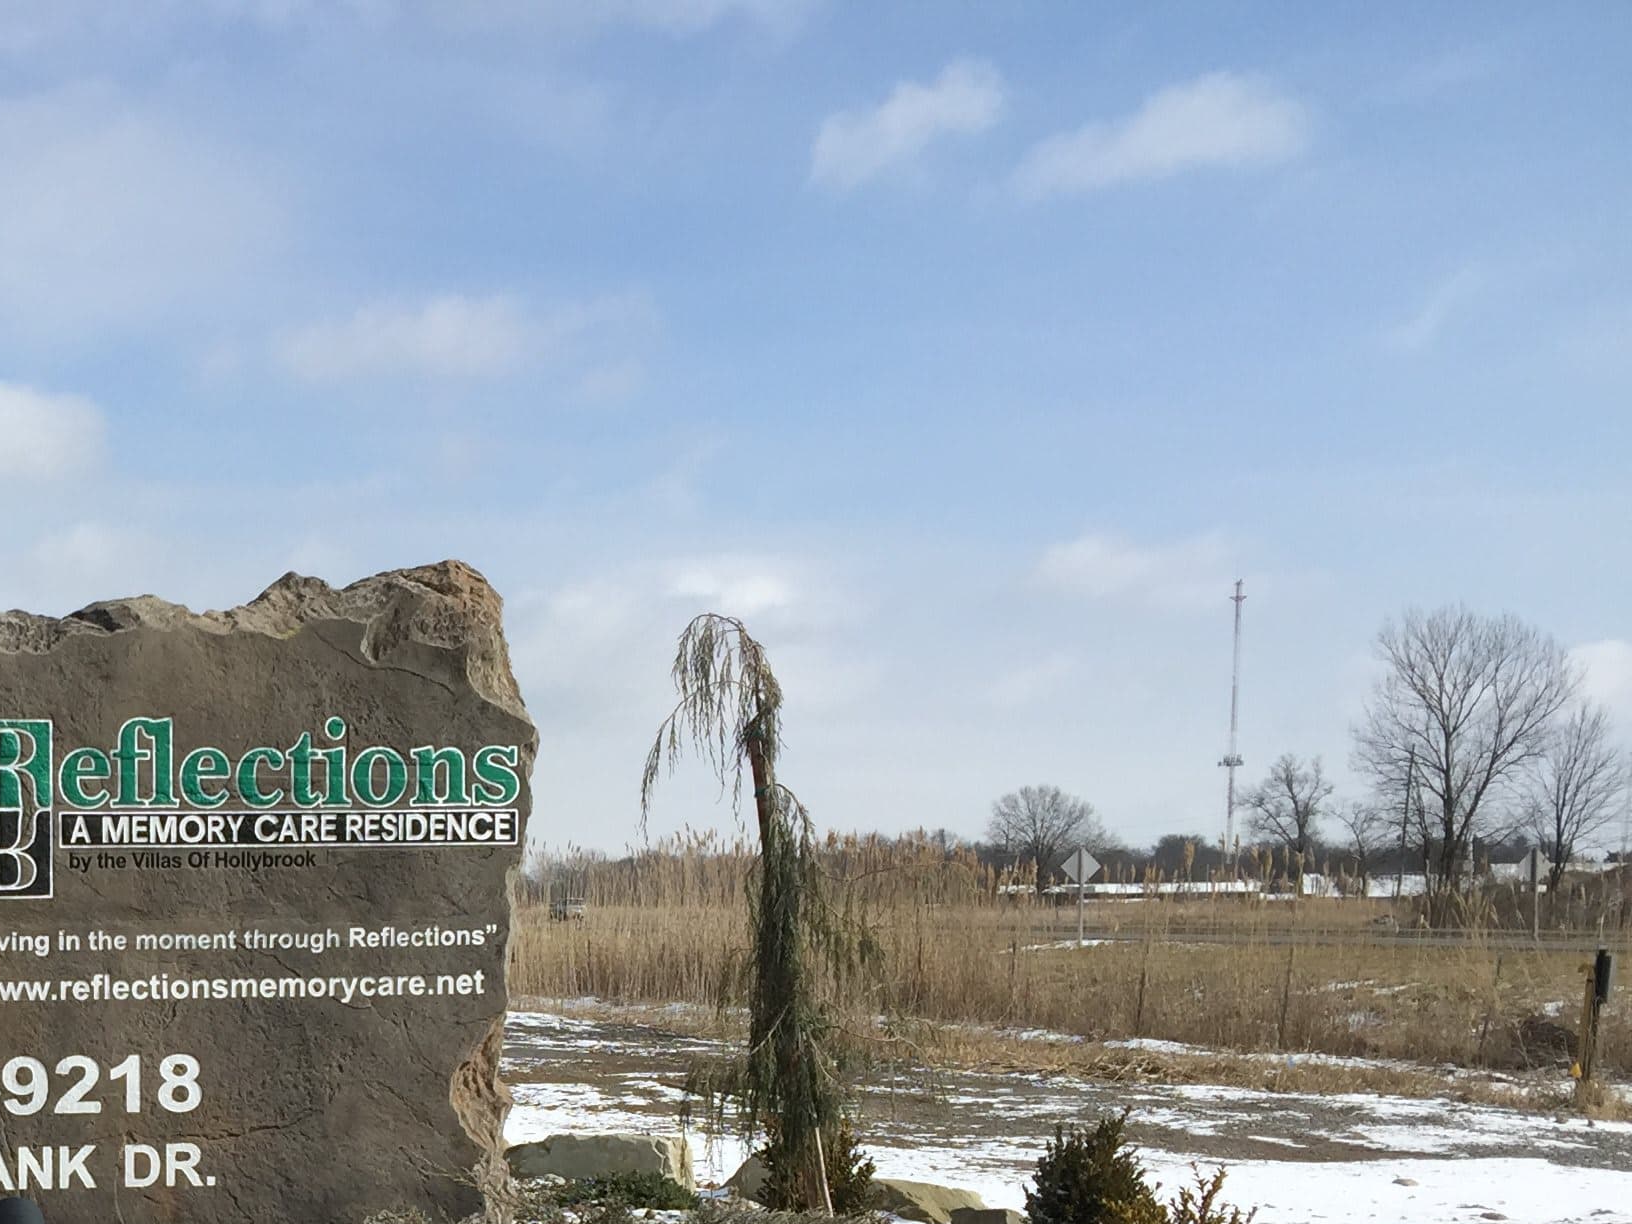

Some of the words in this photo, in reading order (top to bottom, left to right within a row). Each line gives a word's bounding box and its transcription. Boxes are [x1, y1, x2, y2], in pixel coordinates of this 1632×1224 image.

[70, 815, 91, 844] A
[102, 814, 245, 844] MEMORY
[254, 813, 337, 842] CARE
[345, 812, 511, 842] RESIDENCE
[68, 852, 93, 873] by
[98, 852, 126, 869] the
[132, 852, 181, 869] Villas
[188, 852, 209, 869] Of
[215, 851, 317, 872] Hollybrook
[58, 931, 80, 952] in
[88, 931, 127, 951] the
[135, 930, 237, 951] moment
[243, 928, 340, 953] through
[124, 1142, 216, 1189] DR.
